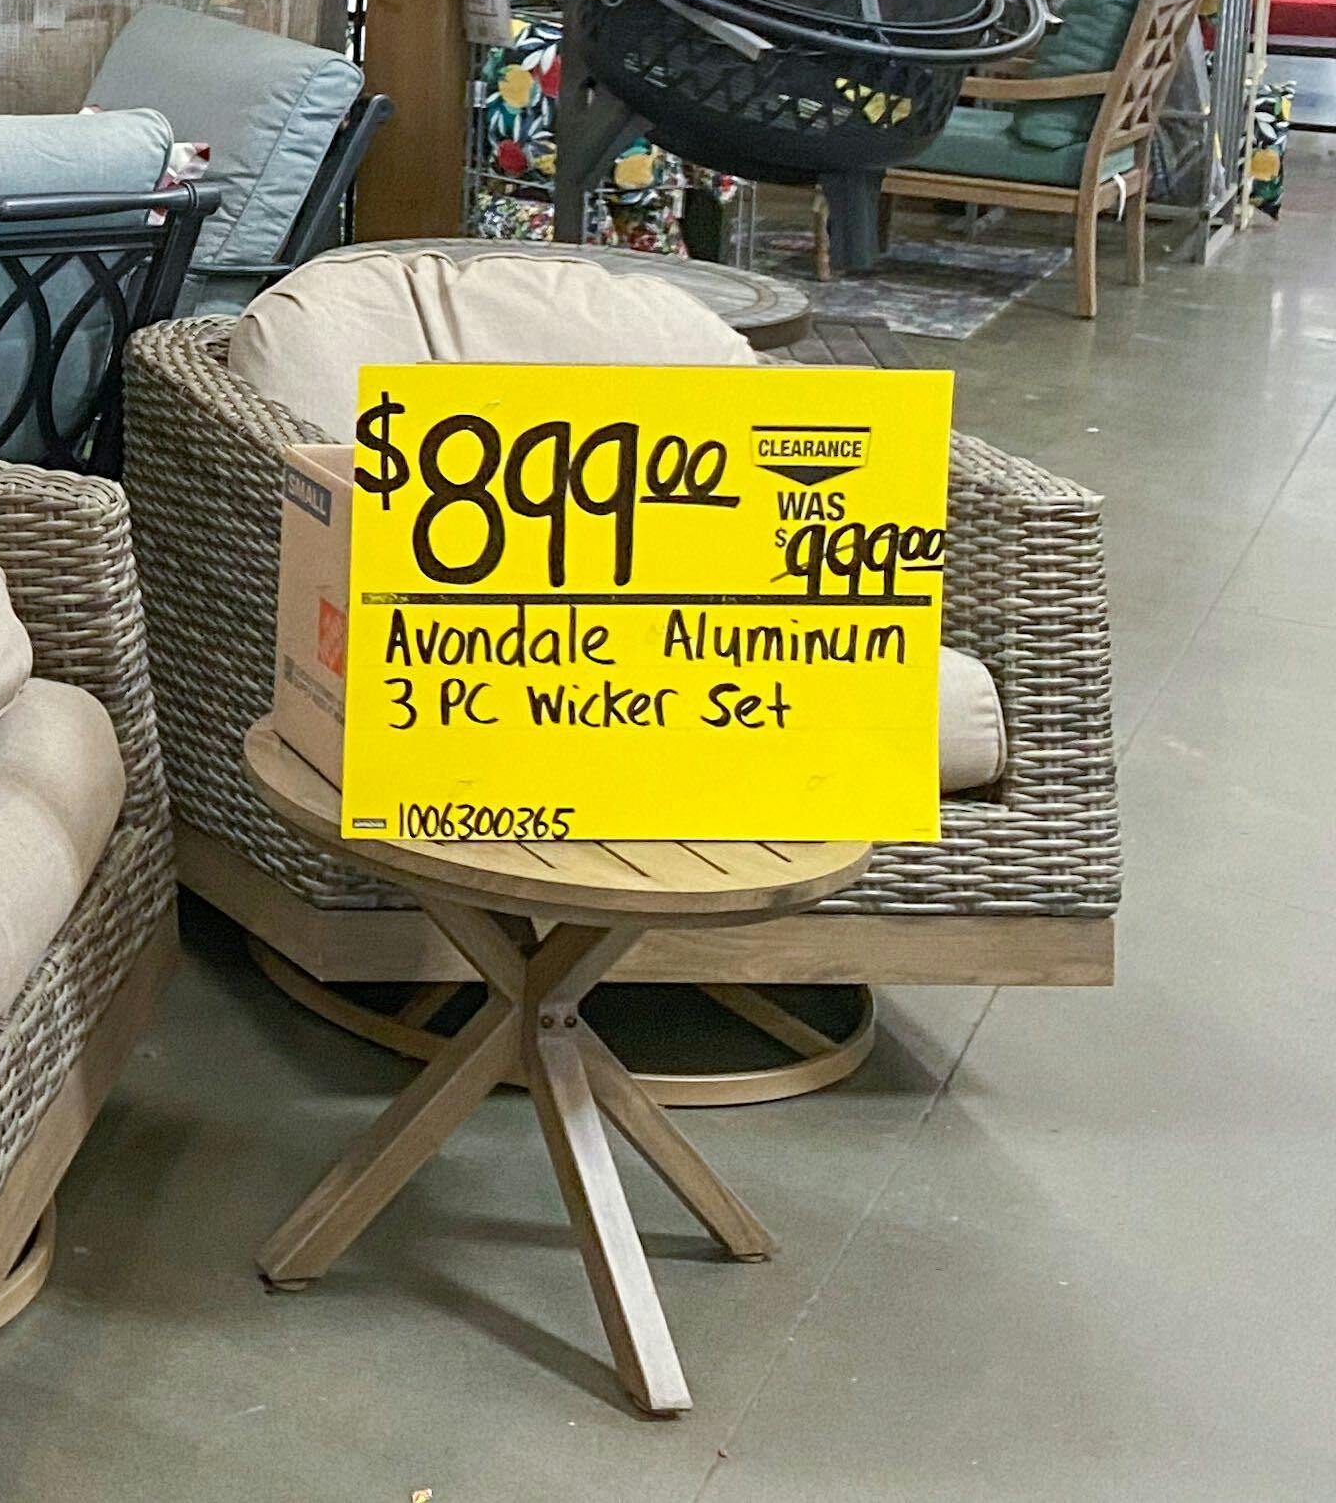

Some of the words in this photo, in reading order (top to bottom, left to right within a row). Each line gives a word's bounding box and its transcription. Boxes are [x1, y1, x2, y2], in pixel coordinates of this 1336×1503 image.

[758, 439, 863, 459] CLEARANCE
[287, 472, 328, 516] SMALL
[777, 492, 846, 522] WAS
[385, 603, 616, 668] Avondale
[665, 608, 906, 668] Aluminum
[384, 678, 418, 730] 3
[440, 679, 498, 726] PC
[701, 681, 793, 729] Set
[399, 802, 576, 840] 1006300365
